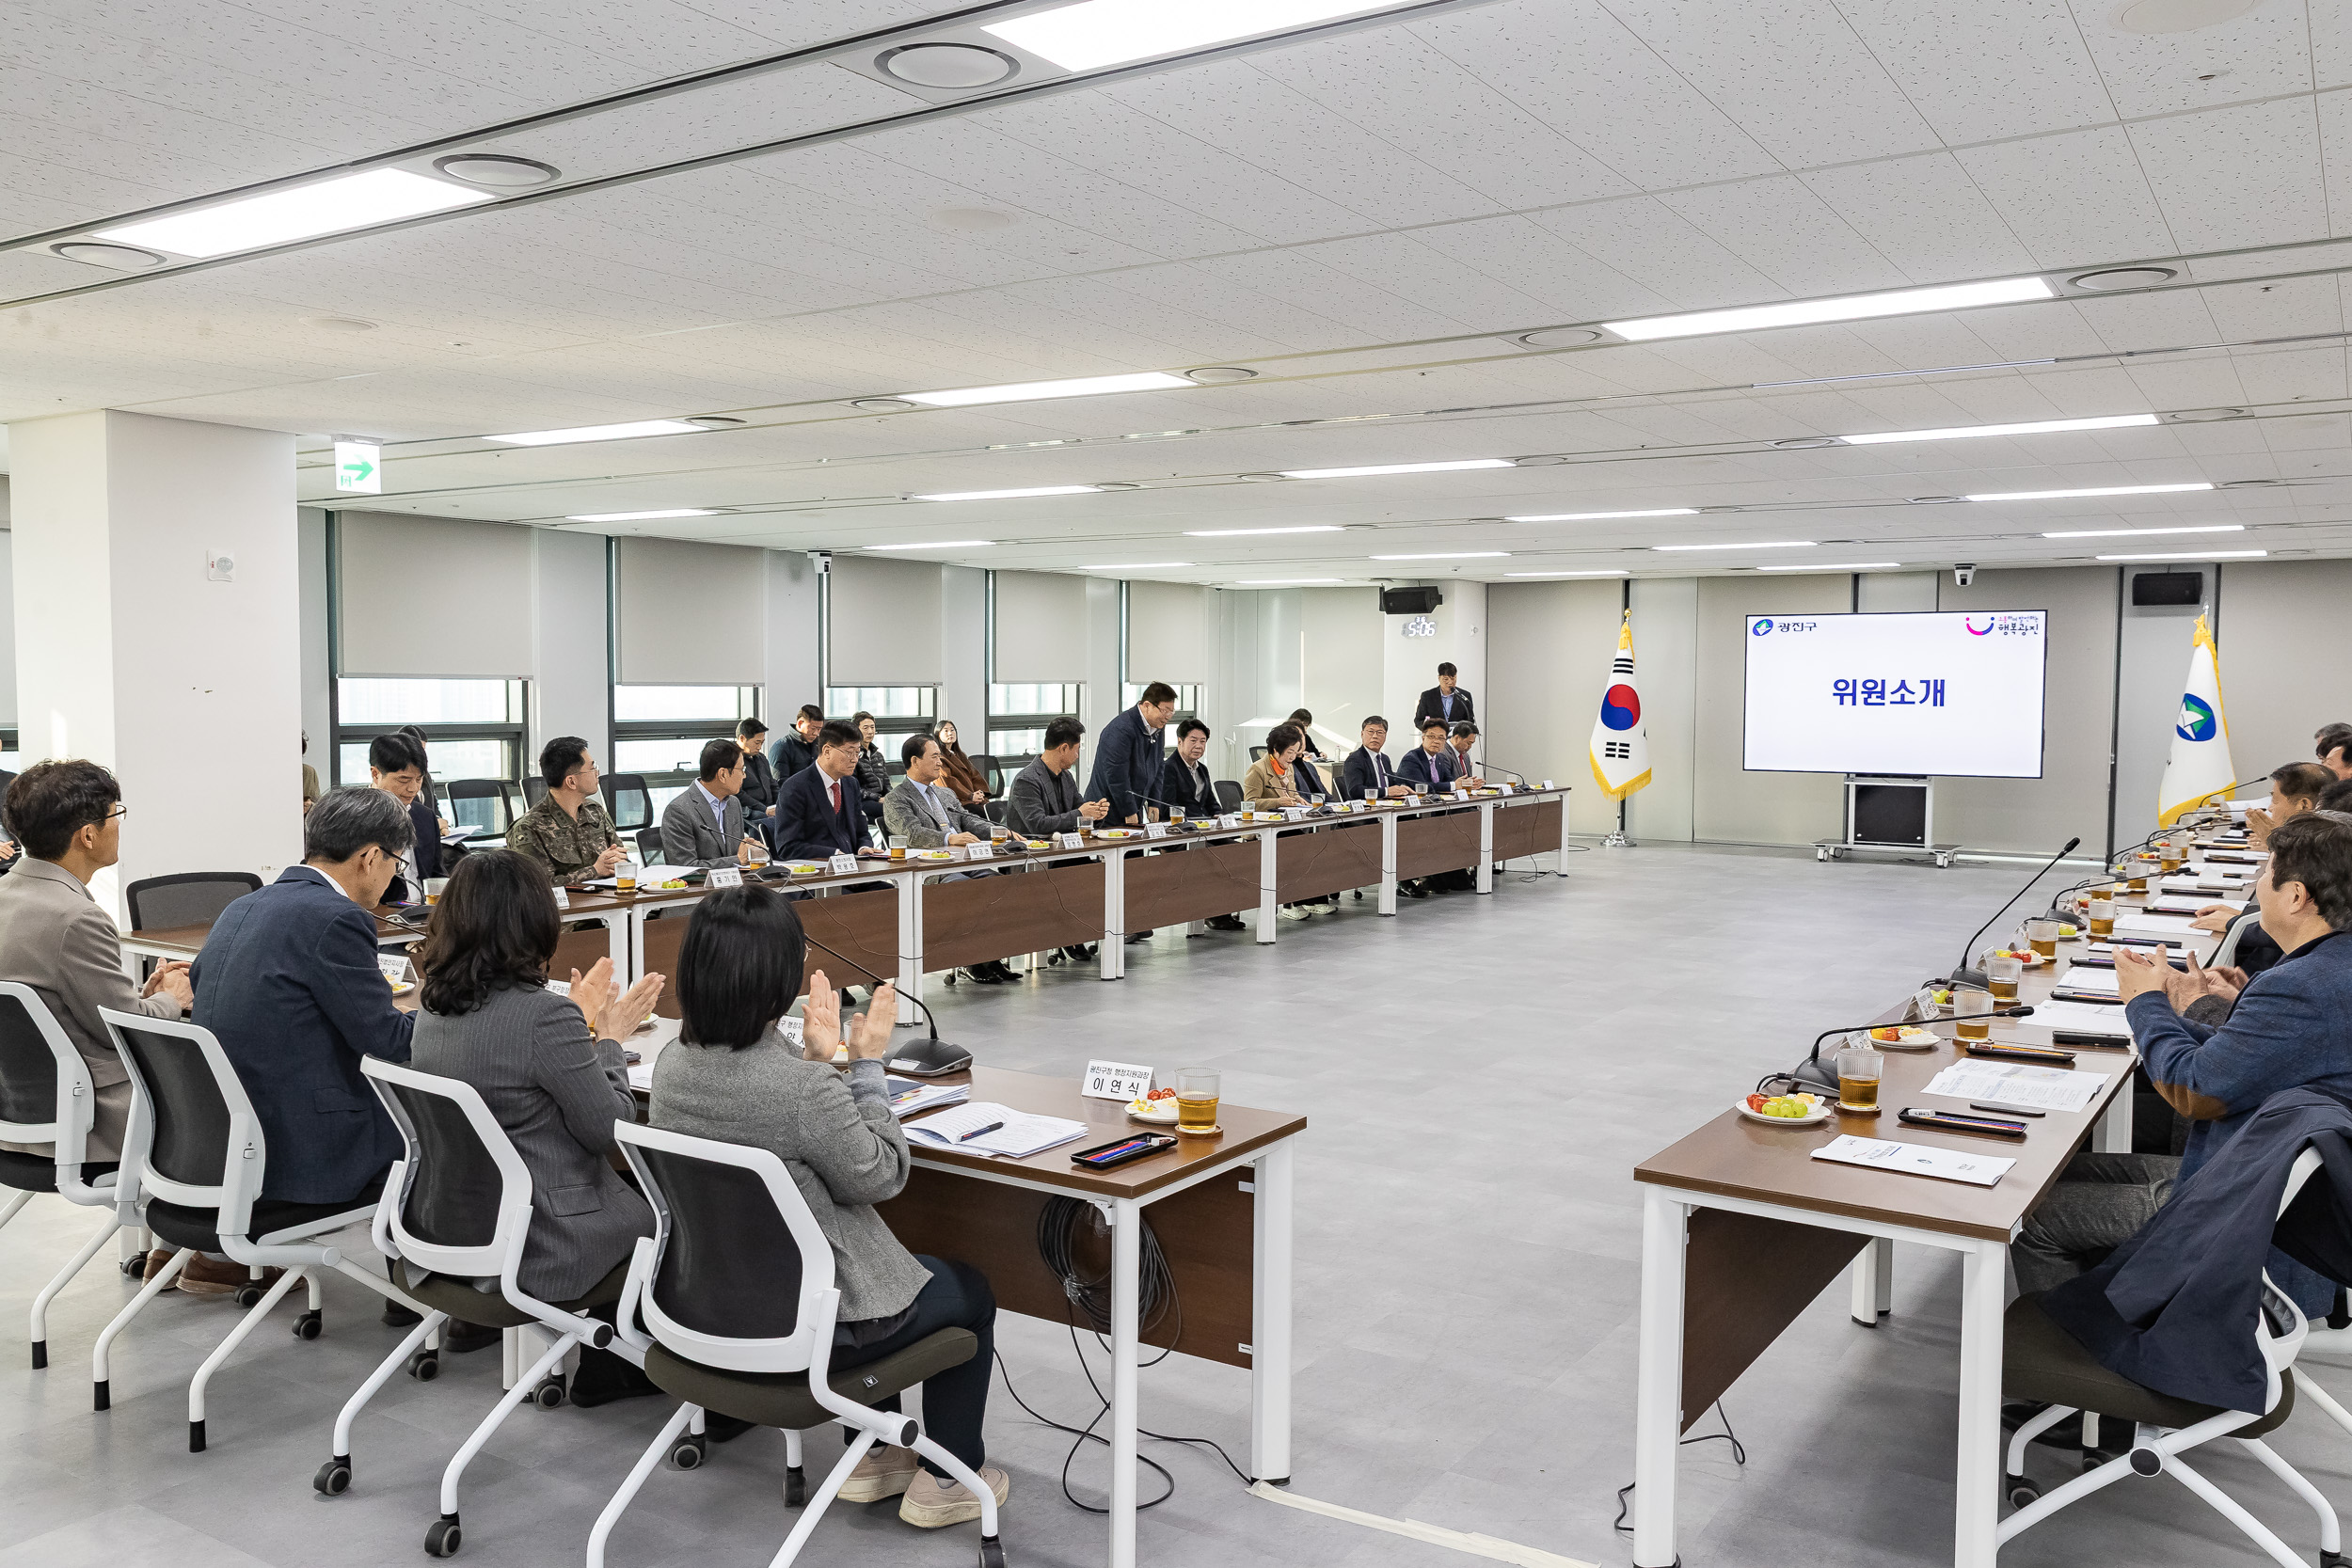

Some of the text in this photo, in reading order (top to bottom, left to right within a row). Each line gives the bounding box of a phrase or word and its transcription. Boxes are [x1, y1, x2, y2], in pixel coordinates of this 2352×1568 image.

[1407, 622, 1436, 637] 5:06
[1777, 622, 1818, 633] 광진구
[1998, 622, 2039, 636] 행복광진
[1832, 678, 1946, 707] 위원소개
[1089, 1065, 1113, 1075] 광진구청
[1093, 1077, 1139, 1096] 이연식
